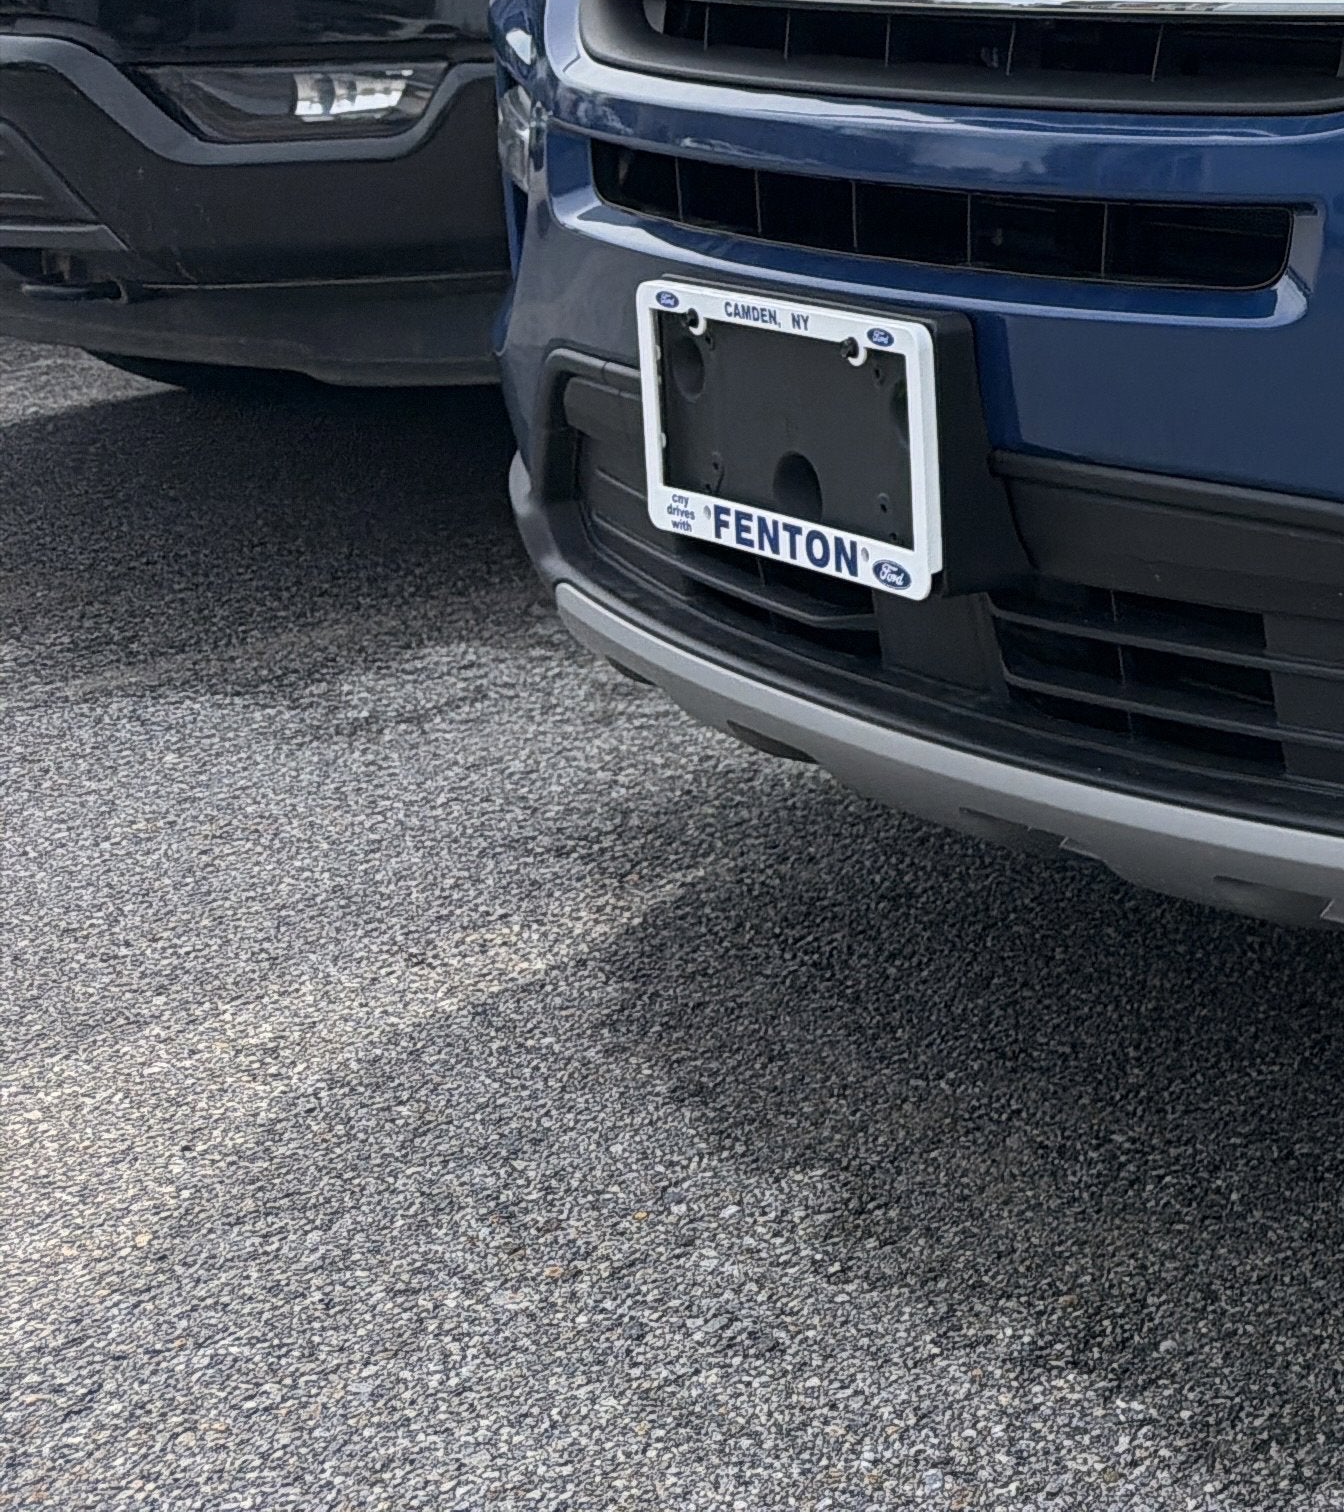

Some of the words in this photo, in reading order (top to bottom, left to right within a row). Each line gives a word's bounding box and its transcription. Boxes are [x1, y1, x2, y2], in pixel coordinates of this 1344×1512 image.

[724, 301, 782, 328] CAMDEN,
[791, 313, 810, 331] NY
[666, 503, 696, 521] drives
[671, 519, 693, 533] with
[713, 503, 859, 578] FENTON
[880, 562, 905, 586] Ford
